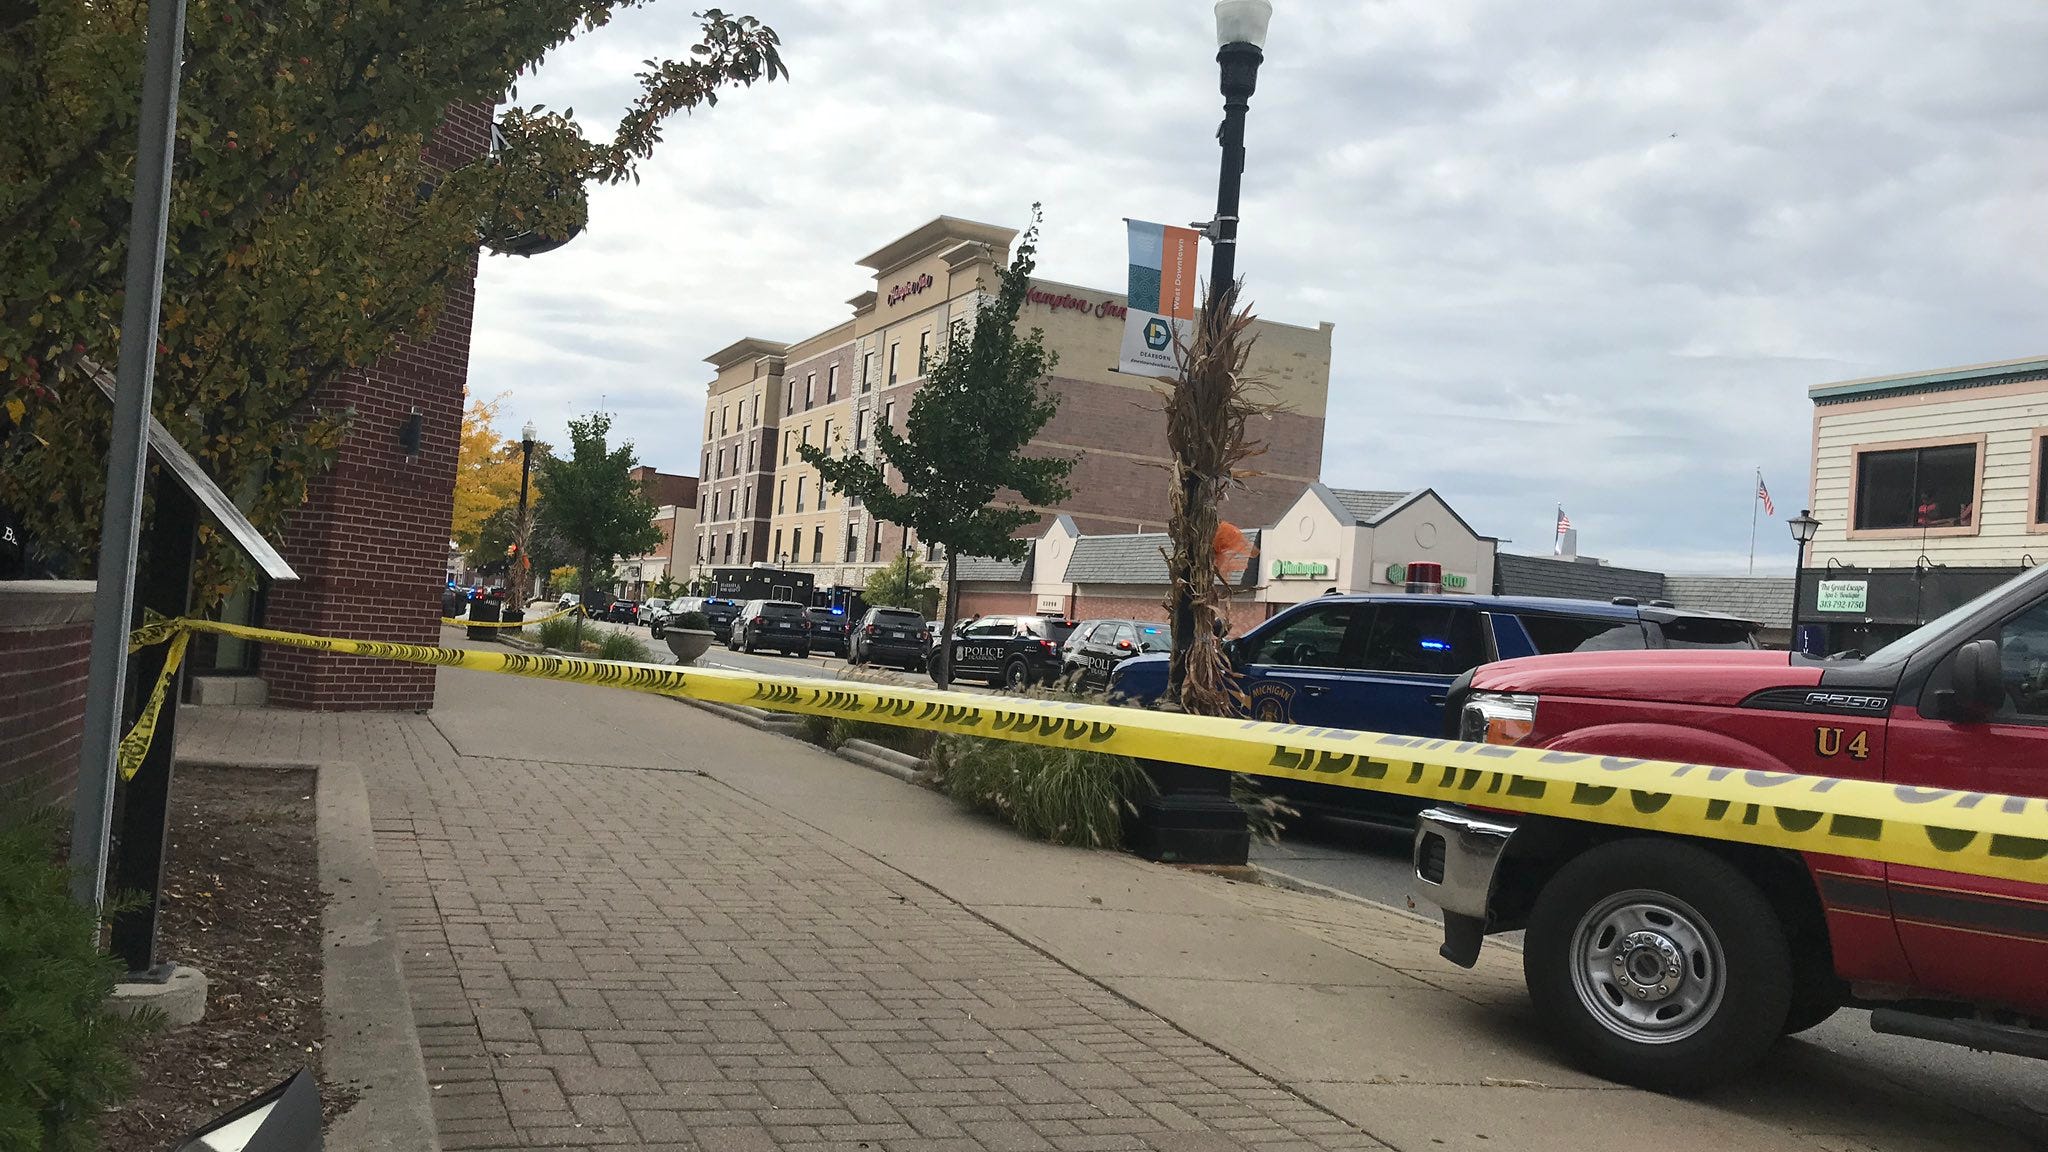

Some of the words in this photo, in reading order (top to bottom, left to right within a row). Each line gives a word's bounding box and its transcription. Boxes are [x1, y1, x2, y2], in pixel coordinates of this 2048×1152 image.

[1175, 238, 1185, 287] Downtown
[1173, 287, 1181, 311] West
[1139, 351, 1171, 362] DEARBORN
[1281, 560, 1328, 577] Huntington
[1820, 583, 1830, 591] The
[1830, 583, 1846, 592] Great
[1846, 583, 1865, 593] Escape
[1819, 600, 1865, 609] 313-792-1750
[964, 646, 1005, 659] POLICE
[1252, 685, 1291, 701] MICHIGAN
[1804, 692, 1888, 711] F-250
